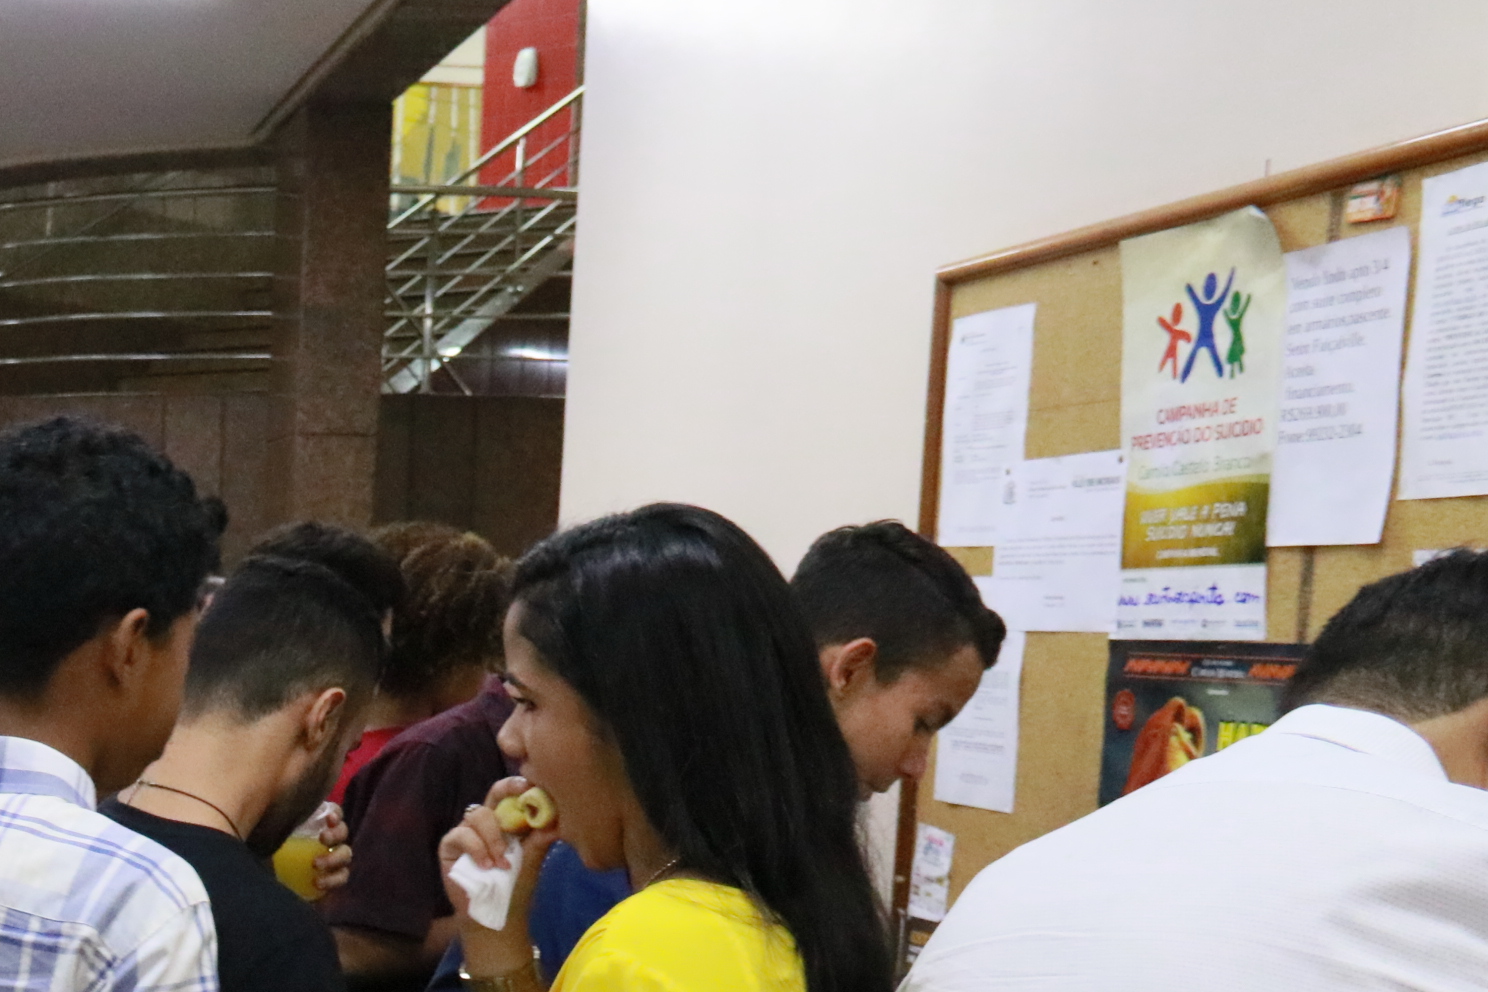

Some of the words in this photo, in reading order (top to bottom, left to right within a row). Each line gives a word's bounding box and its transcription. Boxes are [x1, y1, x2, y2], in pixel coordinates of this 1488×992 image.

[1156, 401, 1220, 425] CAMPANHA
[1222, 397, 1239, 416] DE
[1193, 425, 1212, 444] DO
[1213, 501, 1248, 519] PENA
